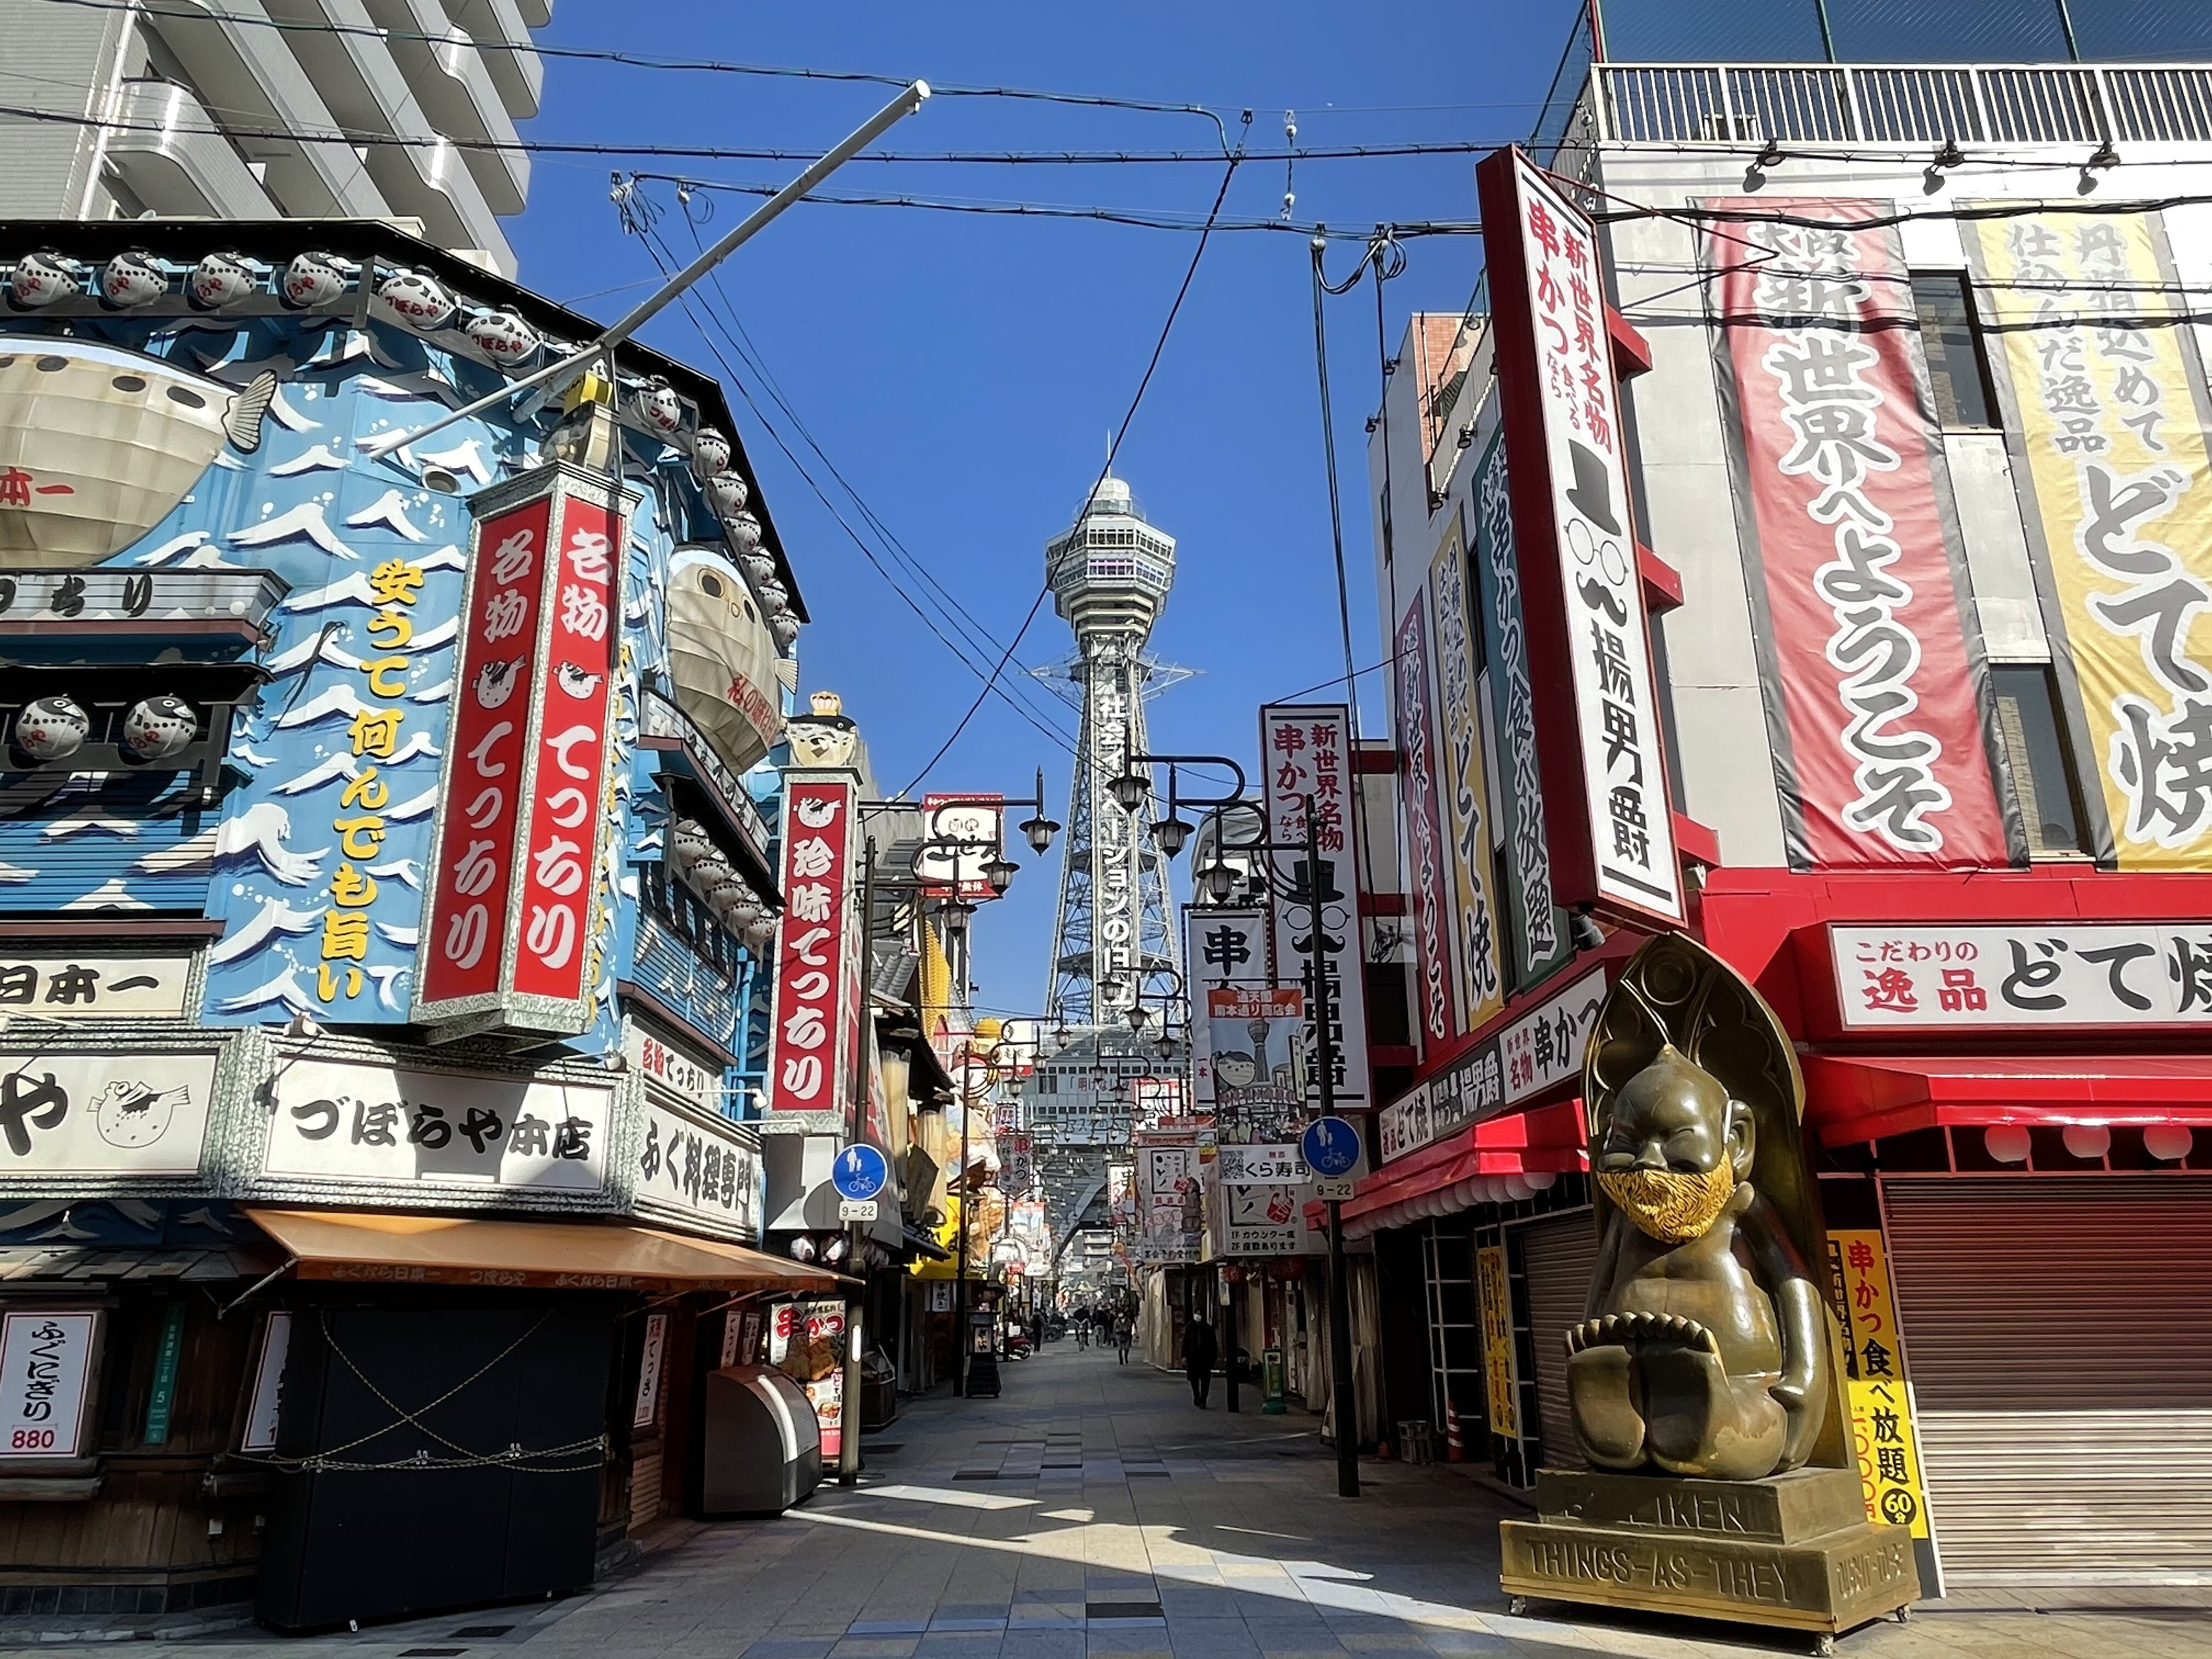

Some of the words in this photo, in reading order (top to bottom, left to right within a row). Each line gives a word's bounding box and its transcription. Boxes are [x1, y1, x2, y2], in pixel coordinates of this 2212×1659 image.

[1527, 195, 1568, 356] 串かつ
[1757, 222, 1854, 256] 大阪
[1547, 352, 1561, 398] なら
[1562, 225, 1612, 454] 新世界名物
[1561, 363, 1581, 431] 食べる
[484, 528, 534, 644] 名物
[560, 527, 613, 642] 名物
[1760, 263, 1943, 844] 新世界へようこそ
[1273, 723, 1307, 812] 串かつ
[1491, 494, 1555, 964] 串かつ食べ放題
[1591, 617, 1651, 871] 揚男爵
[317, 558, 424, 1002] 安うて何んでも旨い
[1310, 723, 1344, 853] 新世界名物
[445, 720, 513, 970] てっちり
[526, 725, 597, 970] てっちり
[1455, 725, 1496, 1008] どて焼
[0, 964, 160, 1004] 日本一
[783, 836, 834, 1099] 珍味てっちり
[1856, 940, 1978, 962] こだわりの
[1864, 967, 1987, 1013] 逸品
[1509, 1049, 1534, 1091] 名物
[1534, 998, 1602, 1080] 串かつ
[0, 1073, 69, 1156] や
[291, 1097, 593, 1161] づぼらや本店
[639, 1117, 752, 1218] ふぐ料理専門
[842, 1205, 874, 1217] 9-22
[1245, 1161, 1311, 1177] くら寿司
[156, 1391, 165, 1403] 5
[1847, 1240, 1910, 1485] 串かつ食べ放題
[12, 1430, 54, 1449] 880
[1885, 1493, 1912, 1513] 60
